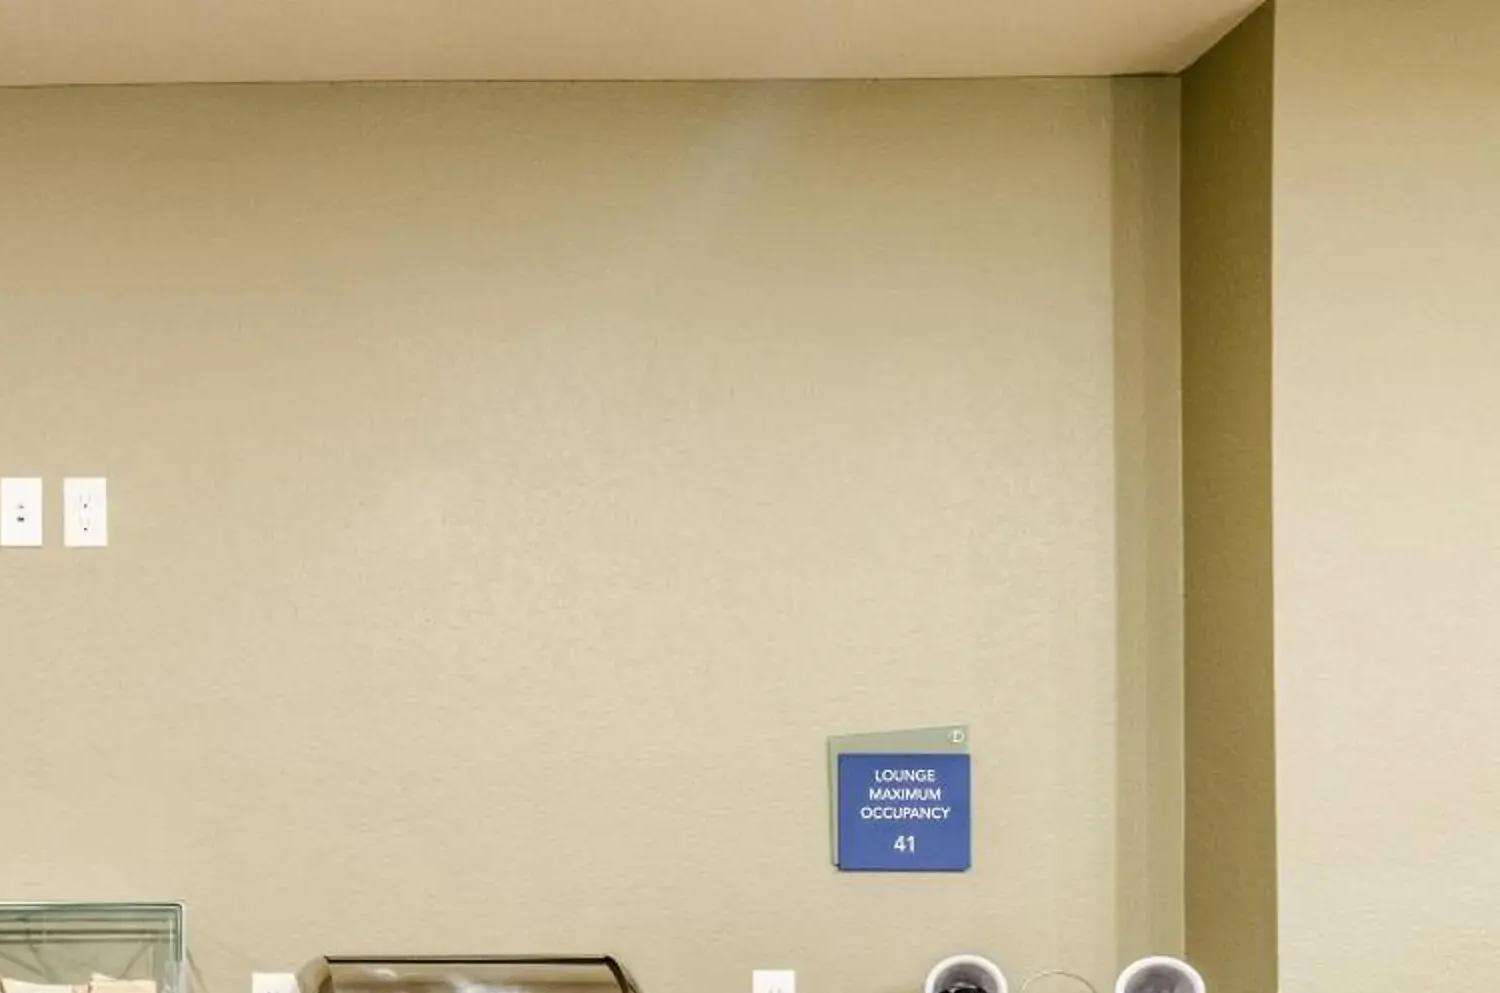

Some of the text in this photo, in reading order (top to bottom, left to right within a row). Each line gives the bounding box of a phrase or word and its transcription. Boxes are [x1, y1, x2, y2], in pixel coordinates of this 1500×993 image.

[875, 769, 936, 782] LOUNGE
[869, 788, 942, 801] MAXIMUM
[860, 806, 951, 819] OCCUPANCY
[893, 835, 915, 853] 41
